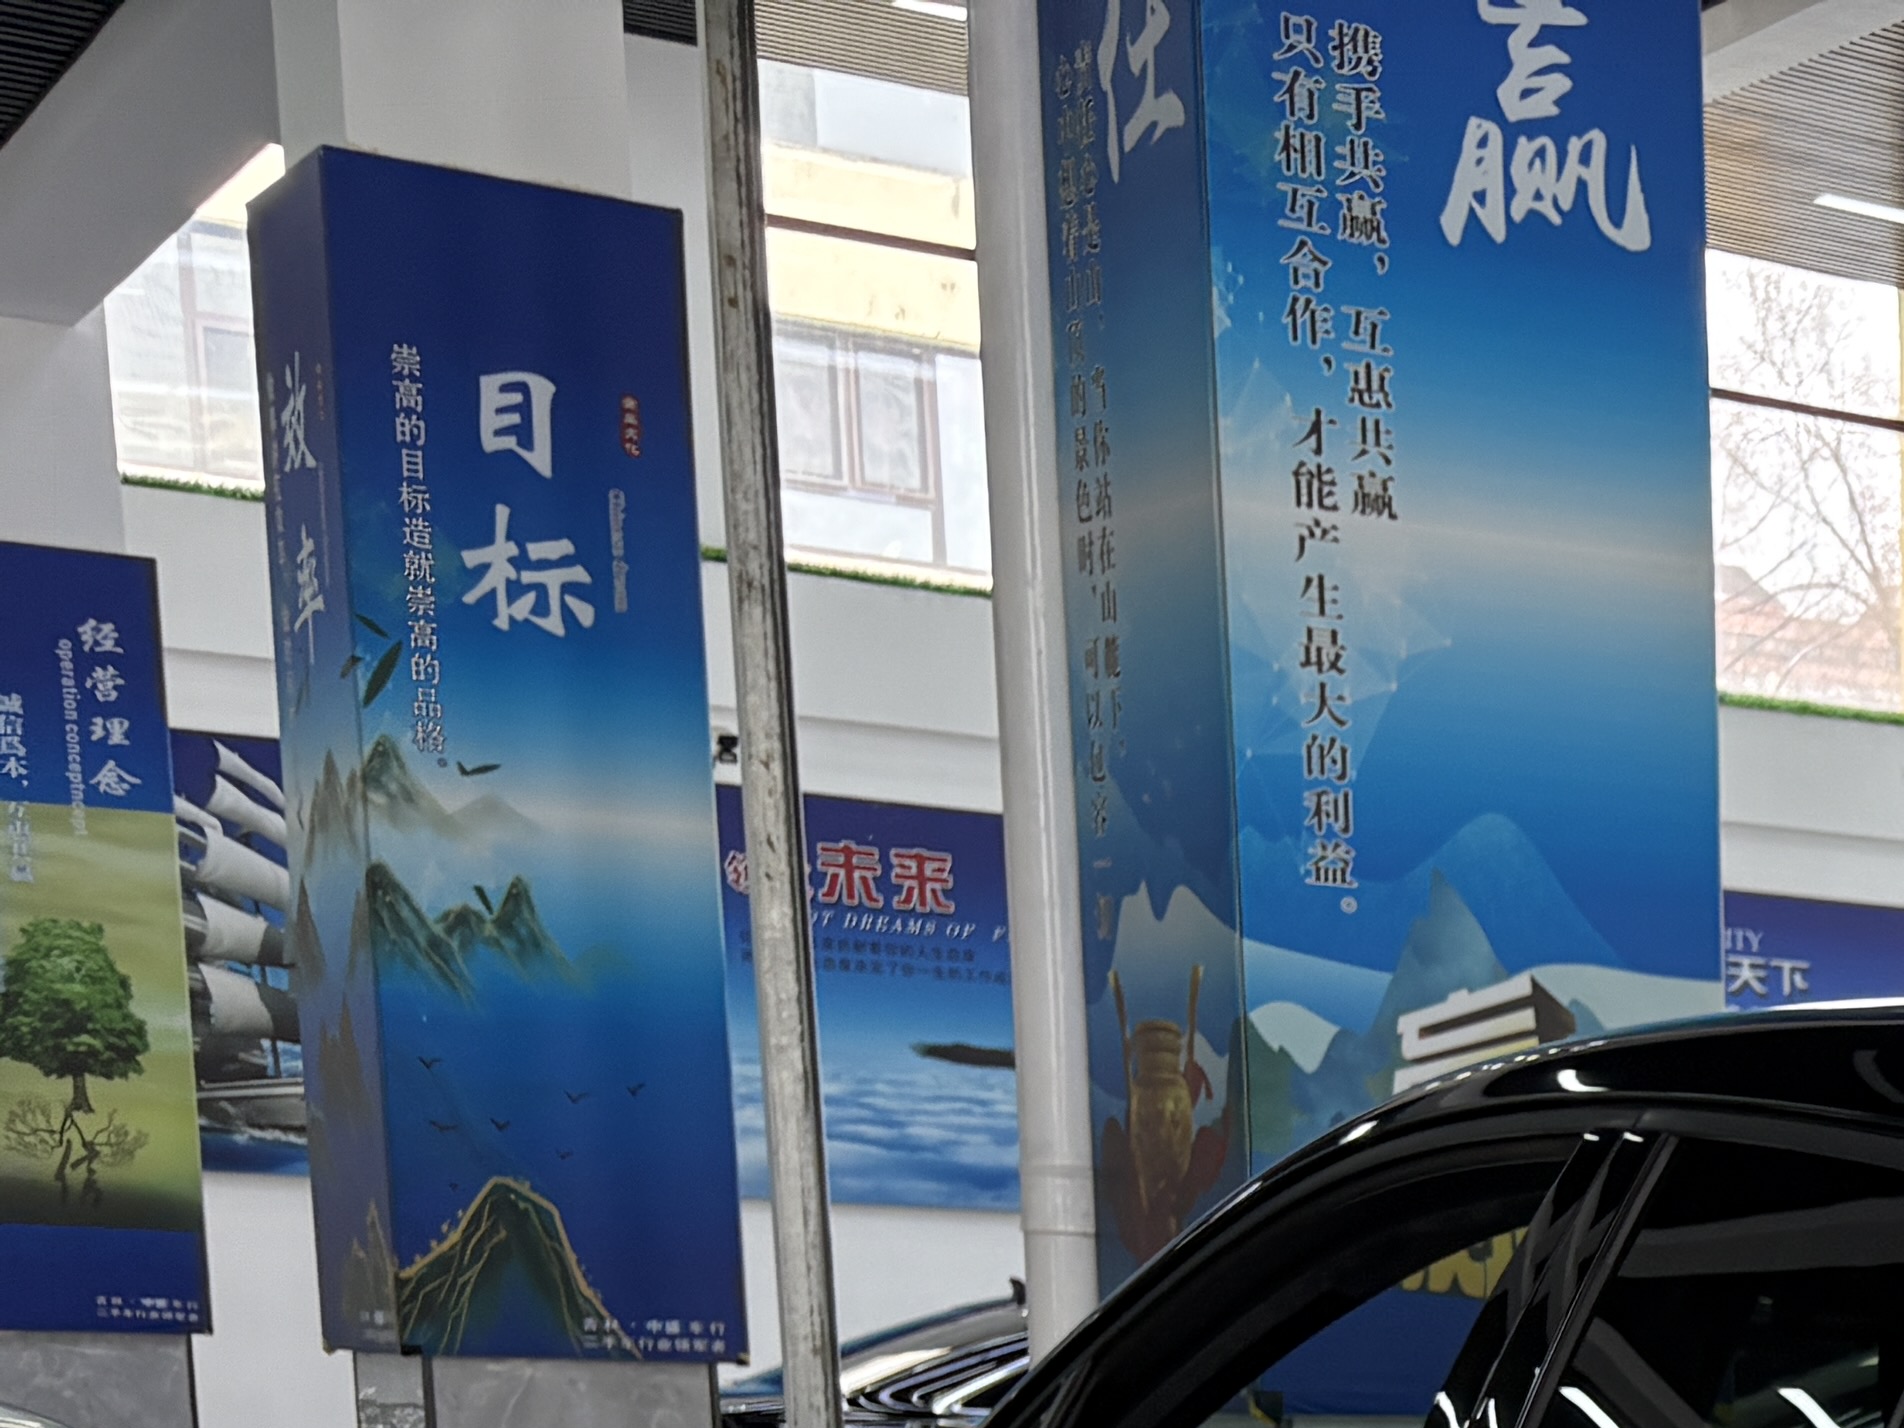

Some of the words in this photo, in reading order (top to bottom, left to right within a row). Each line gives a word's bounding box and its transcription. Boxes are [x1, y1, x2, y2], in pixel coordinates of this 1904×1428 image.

[461, 370, 597, 639] 目标
[54, 638, 82, 721] operation
[77, 617, 142, 797] 经营理念
